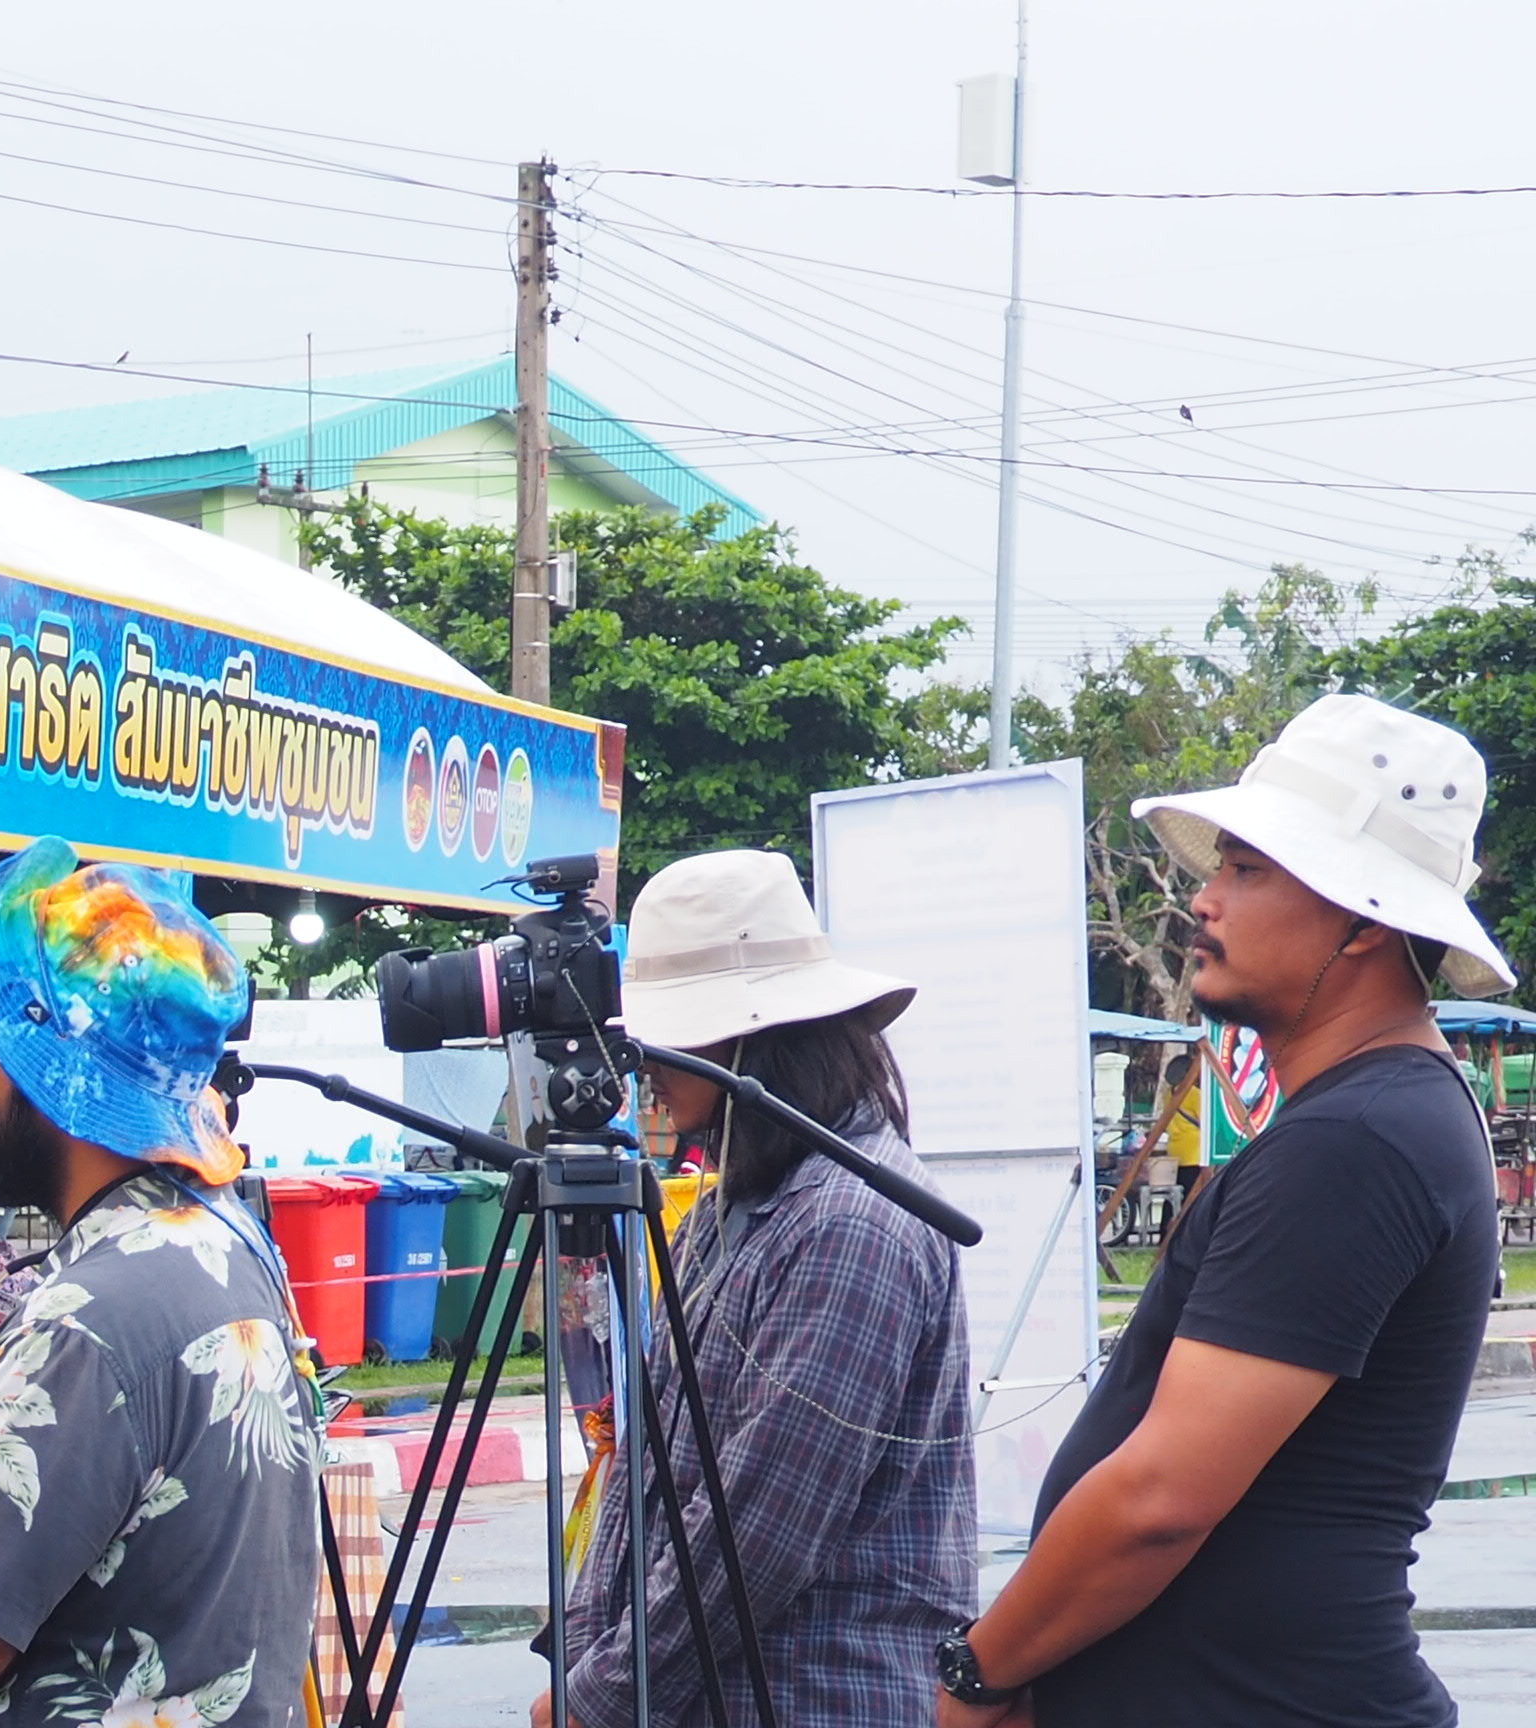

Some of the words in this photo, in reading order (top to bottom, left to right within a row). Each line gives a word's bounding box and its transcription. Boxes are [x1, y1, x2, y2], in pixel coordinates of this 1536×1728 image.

[113, 635, 378, 851] สัมมาชีพชุมชน
[476, 786, 498, 815] OTOP
